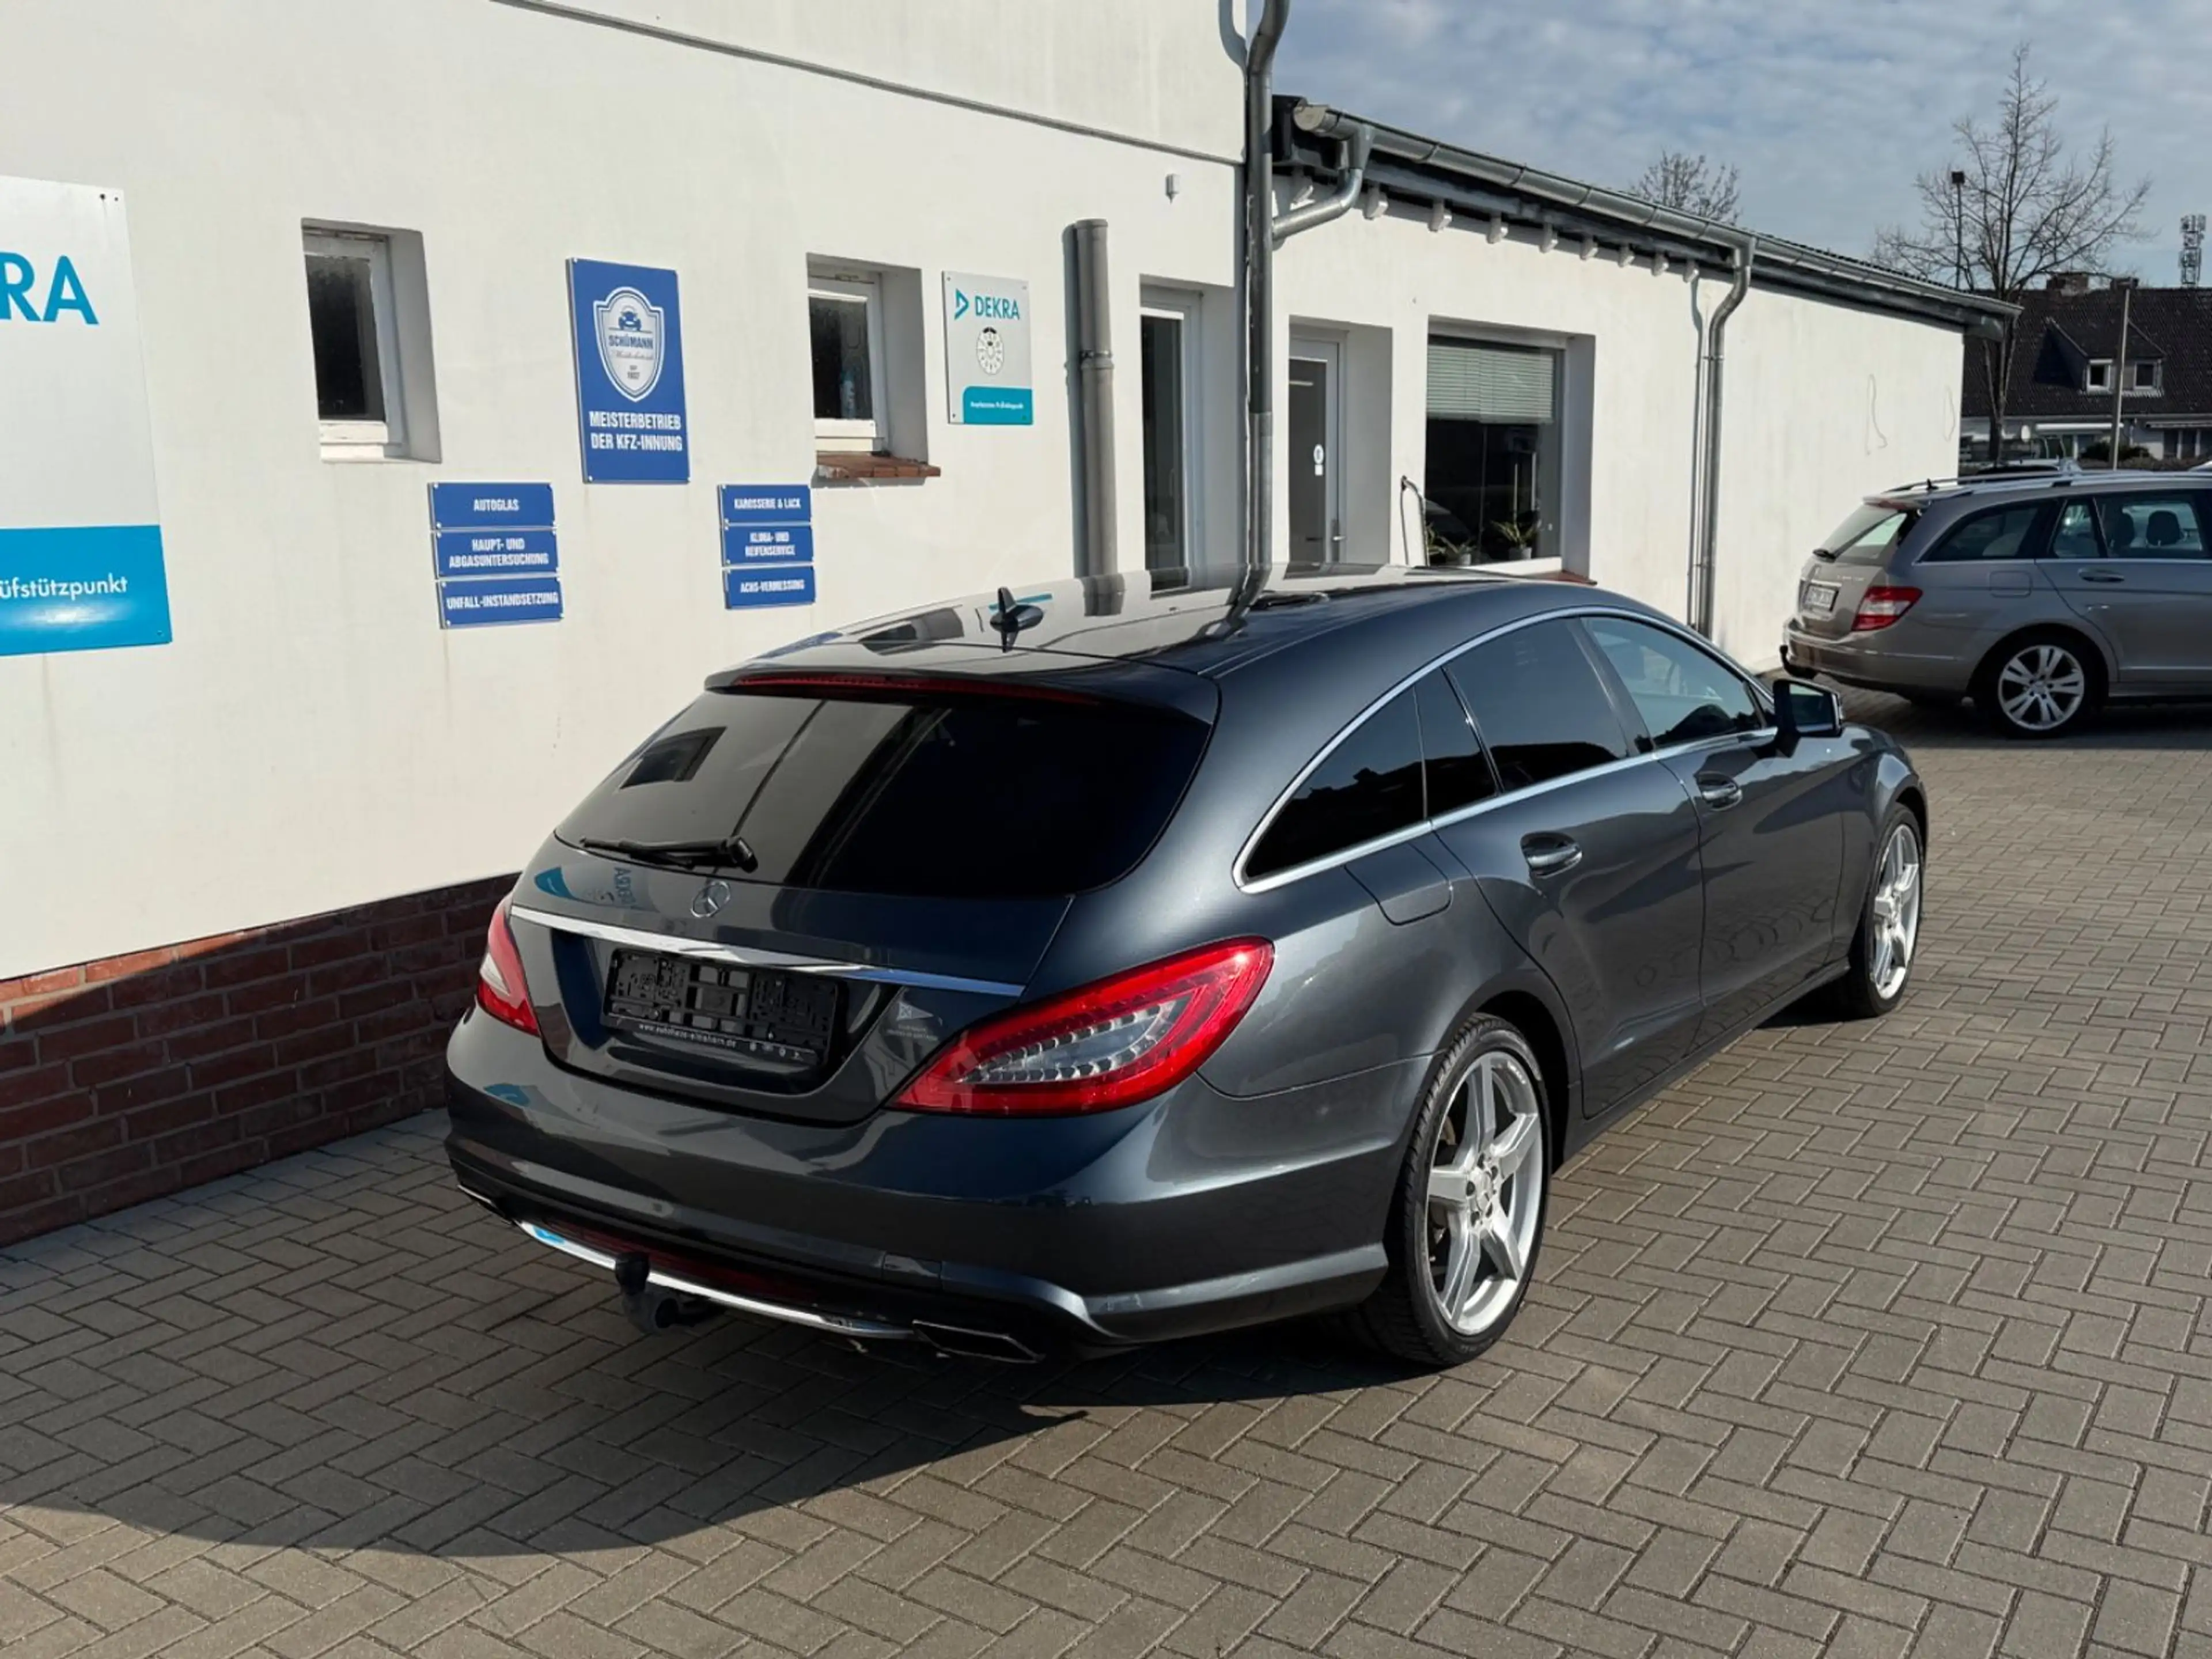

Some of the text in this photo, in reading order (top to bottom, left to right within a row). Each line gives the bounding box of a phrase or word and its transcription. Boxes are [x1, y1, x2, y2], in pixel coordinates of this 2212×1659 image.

[974, 296, 1020, 320] DEKRA
[589, 411, 681, 430] MEISTERBETRIEB
[590, 433, 683, 452] DER KFZ-INNUNG
[474, 499, 520, 512] AUTOGLAS
[784, 498, 801, 509] LACK
[471, 537, 525, 551] HAUPT- UND
[449, 552, 550, 569] ABGASUNTERSUCHUNG
[446, 592, 559, 610] UNFALL-INSTANDSETZUNG
